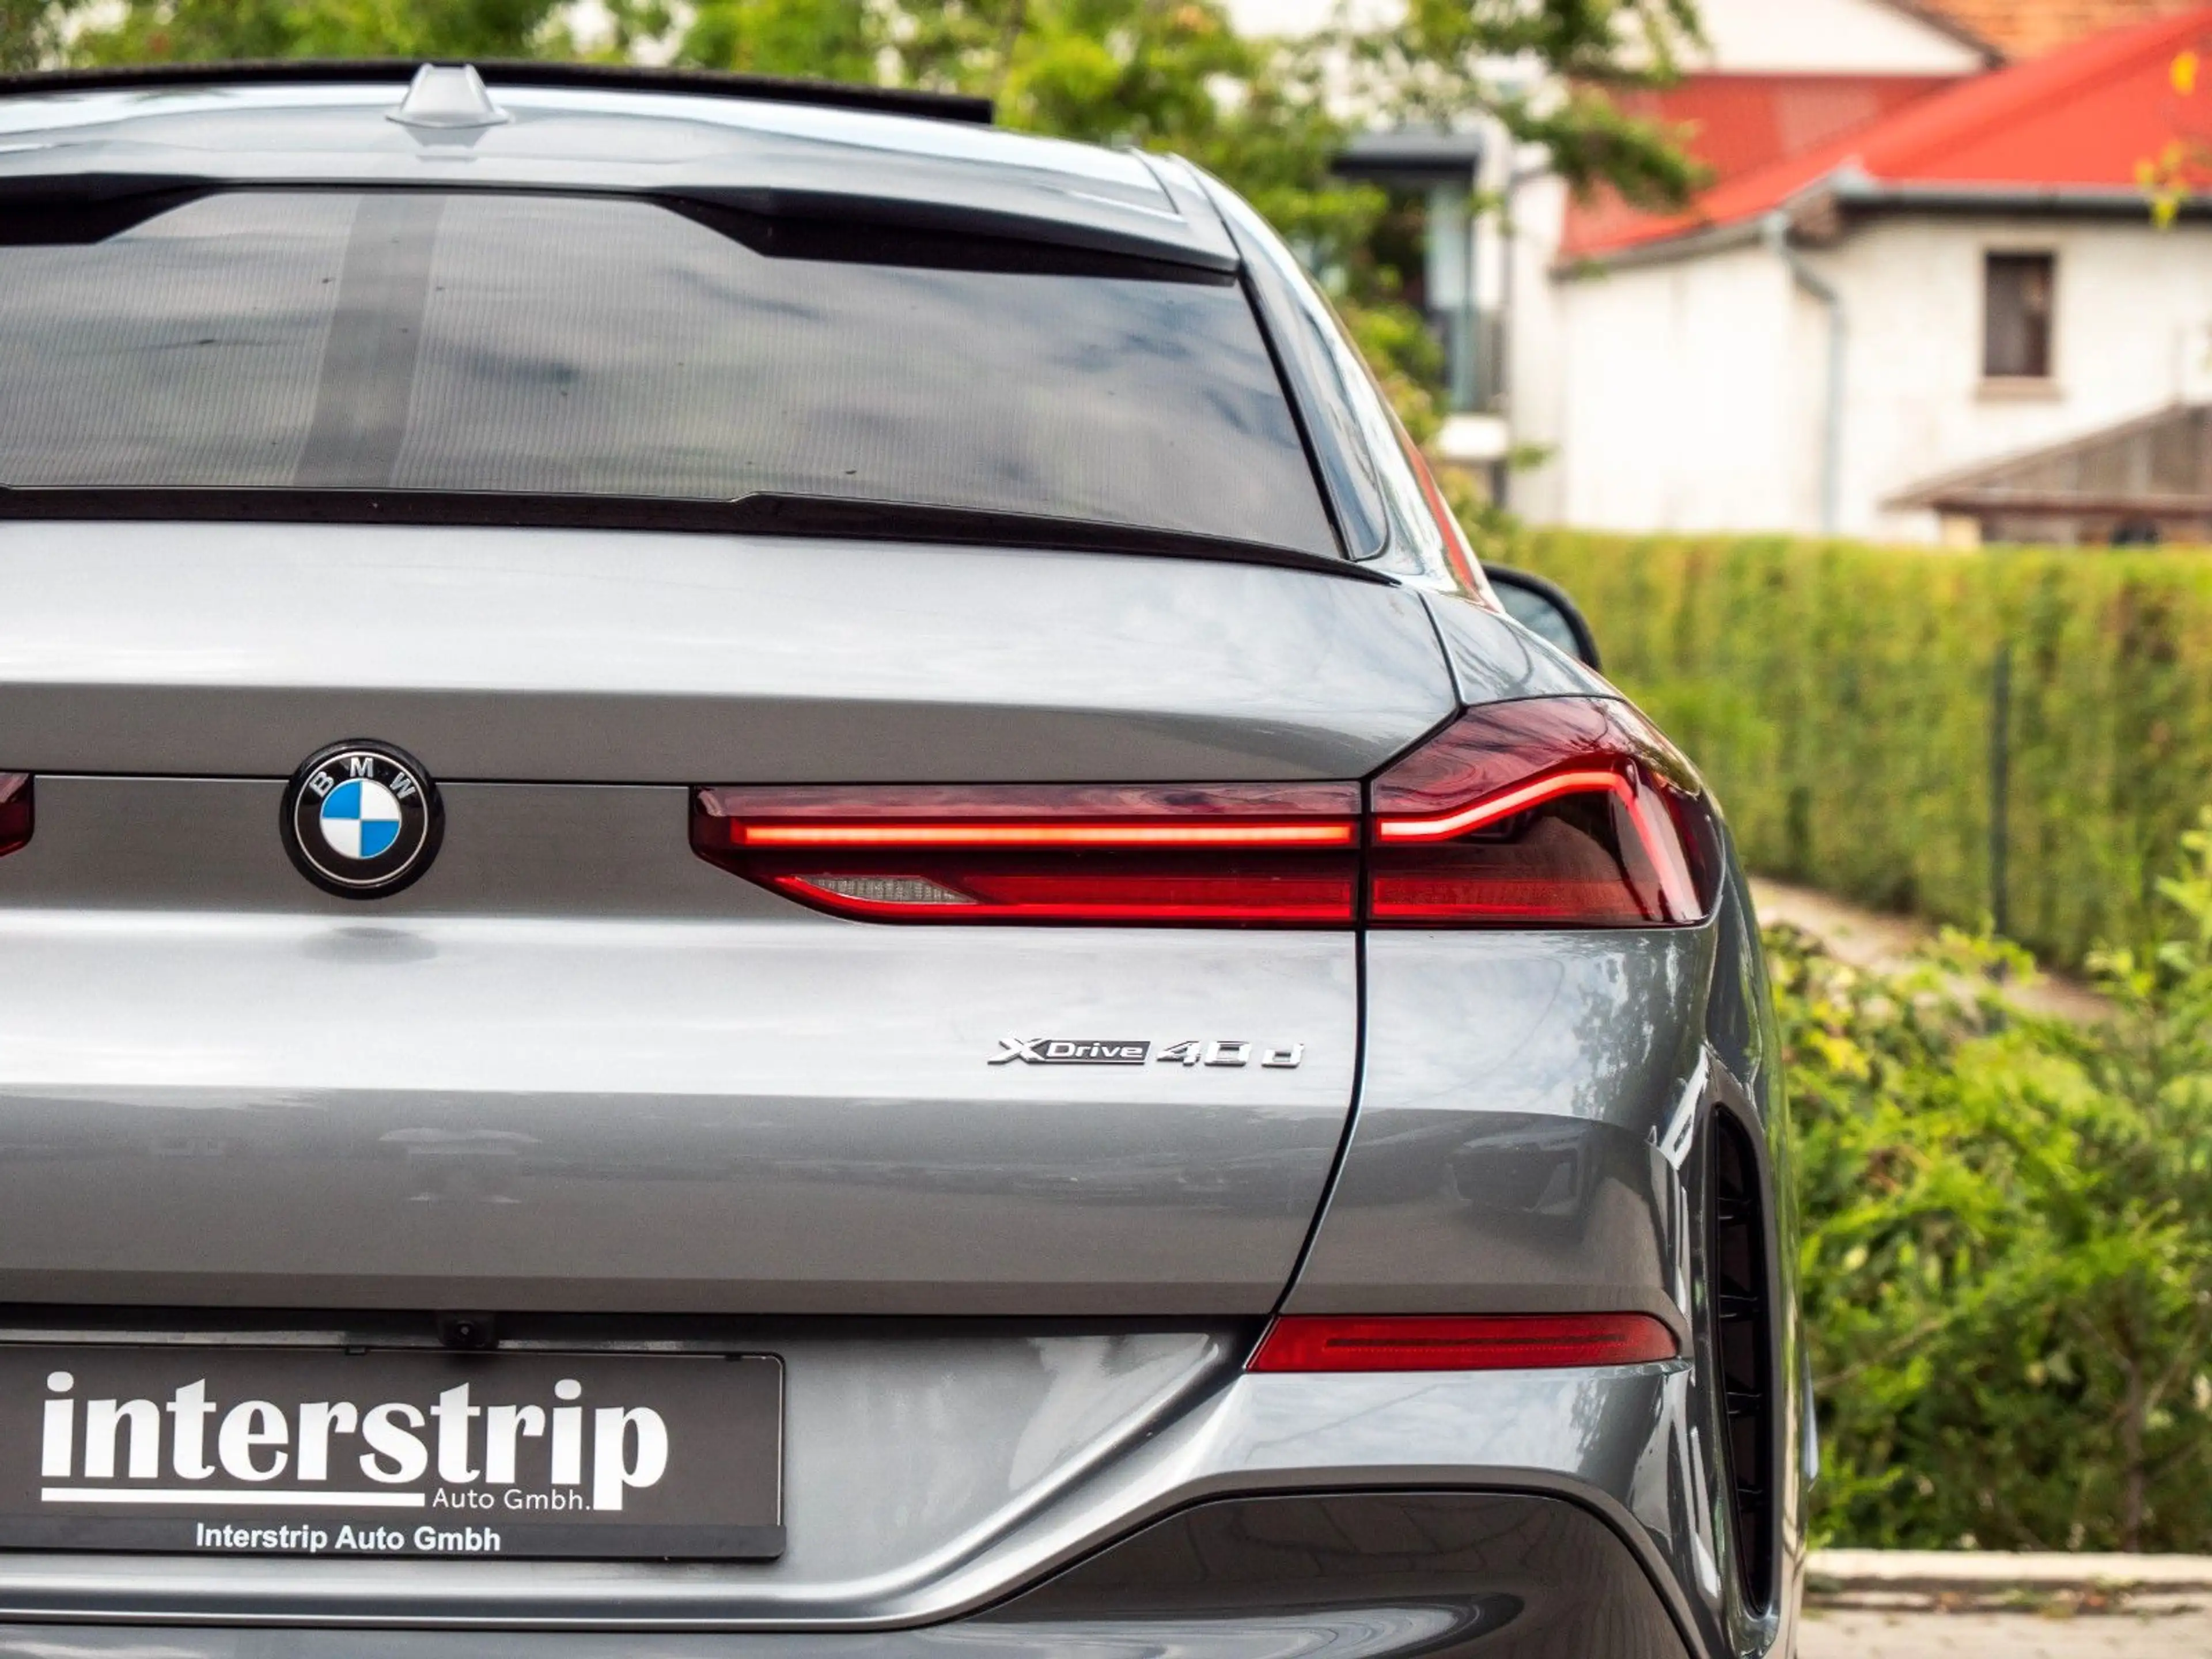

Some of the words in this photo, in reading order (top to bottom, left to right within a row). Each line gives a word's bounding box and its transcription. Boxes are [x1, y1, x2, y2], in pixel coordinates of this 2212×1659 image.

[309, 757, 416, 798] BMW
[41, 1371, 669, 1510] interstrip
[433, 1487, 495, 1509] Auto
[503, 1488, 592, 1510] Gmbh.
[196, 1522, 328, 1552] Interstrip
[335, 1525, 404, 1550] Auto
[414, 1526, 501, 1551] Gmbh
